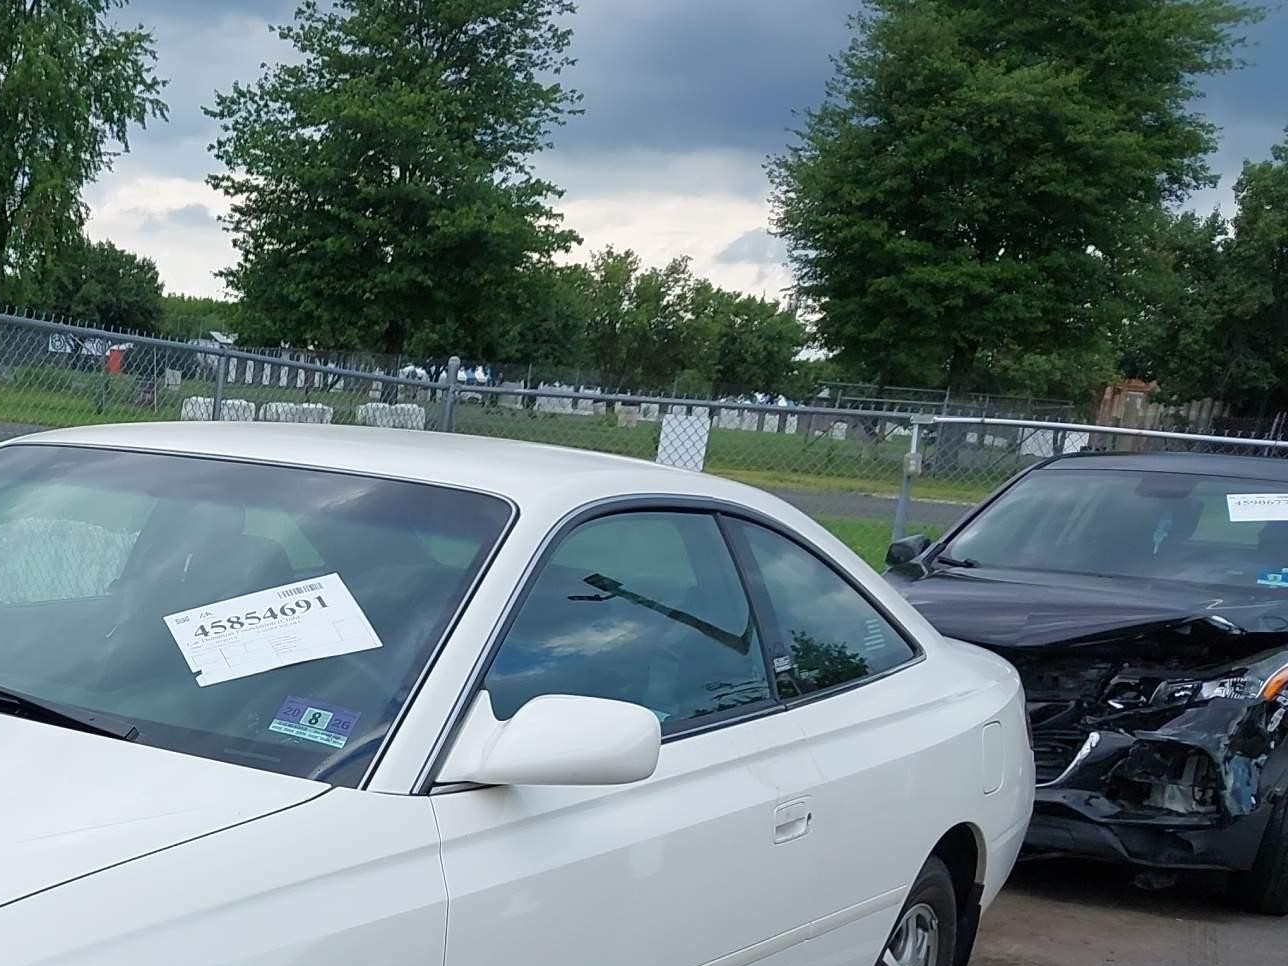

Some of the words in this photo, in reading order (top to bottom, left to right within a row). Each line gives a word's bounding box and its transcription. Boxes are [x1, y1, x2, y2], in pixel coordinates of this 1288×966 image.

[194, 595, 328, 637] 45854691
[283, 706, 301, 718] 20
[308, 711, 322, 726] 8
[332, 718, 351, 730] 26
